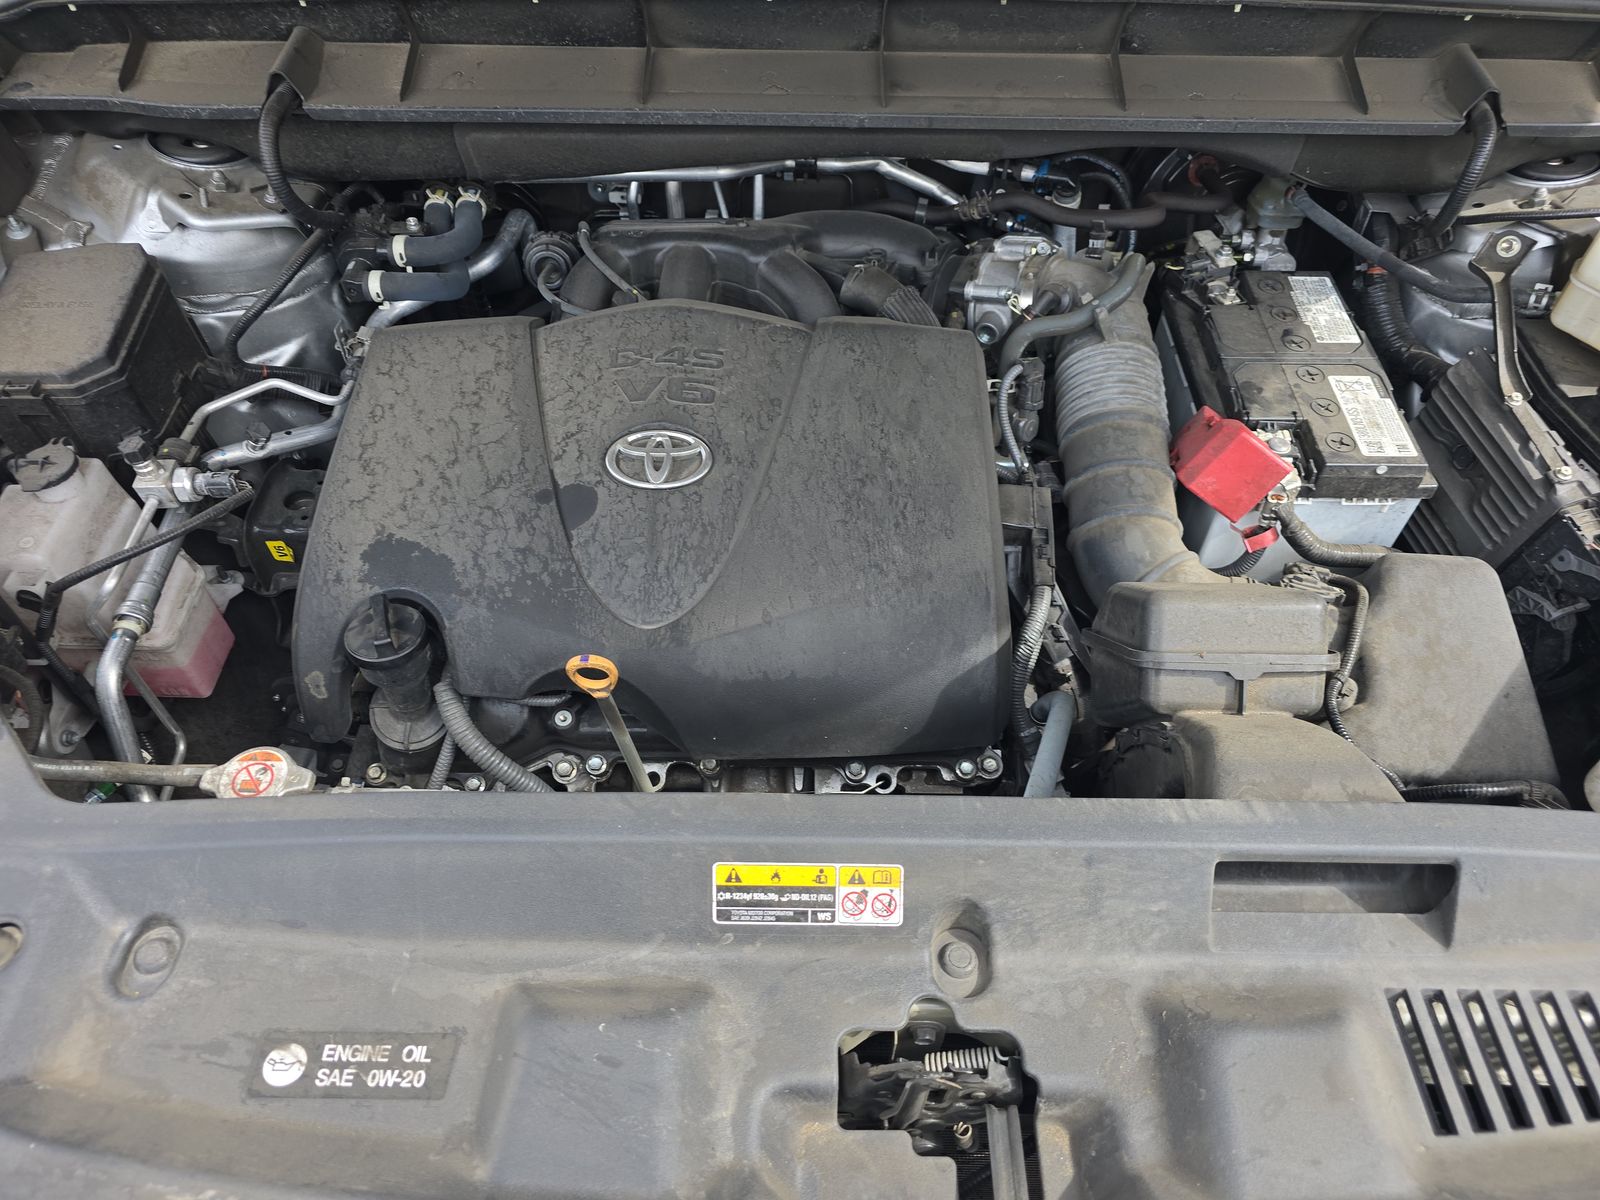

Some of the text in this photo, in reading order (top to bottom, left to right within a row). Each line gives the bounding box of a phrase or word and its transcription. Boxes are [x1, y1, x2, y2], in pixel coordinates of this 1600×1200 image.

[613, 375, 720, 407] V6
[273, 546, 288, 557] V6
[817, 912, 832, 921] WS
[321, 1044, 431, 1064] ENGINE OIL
[314, 1068, 426, 1089] SAE 0W-20
